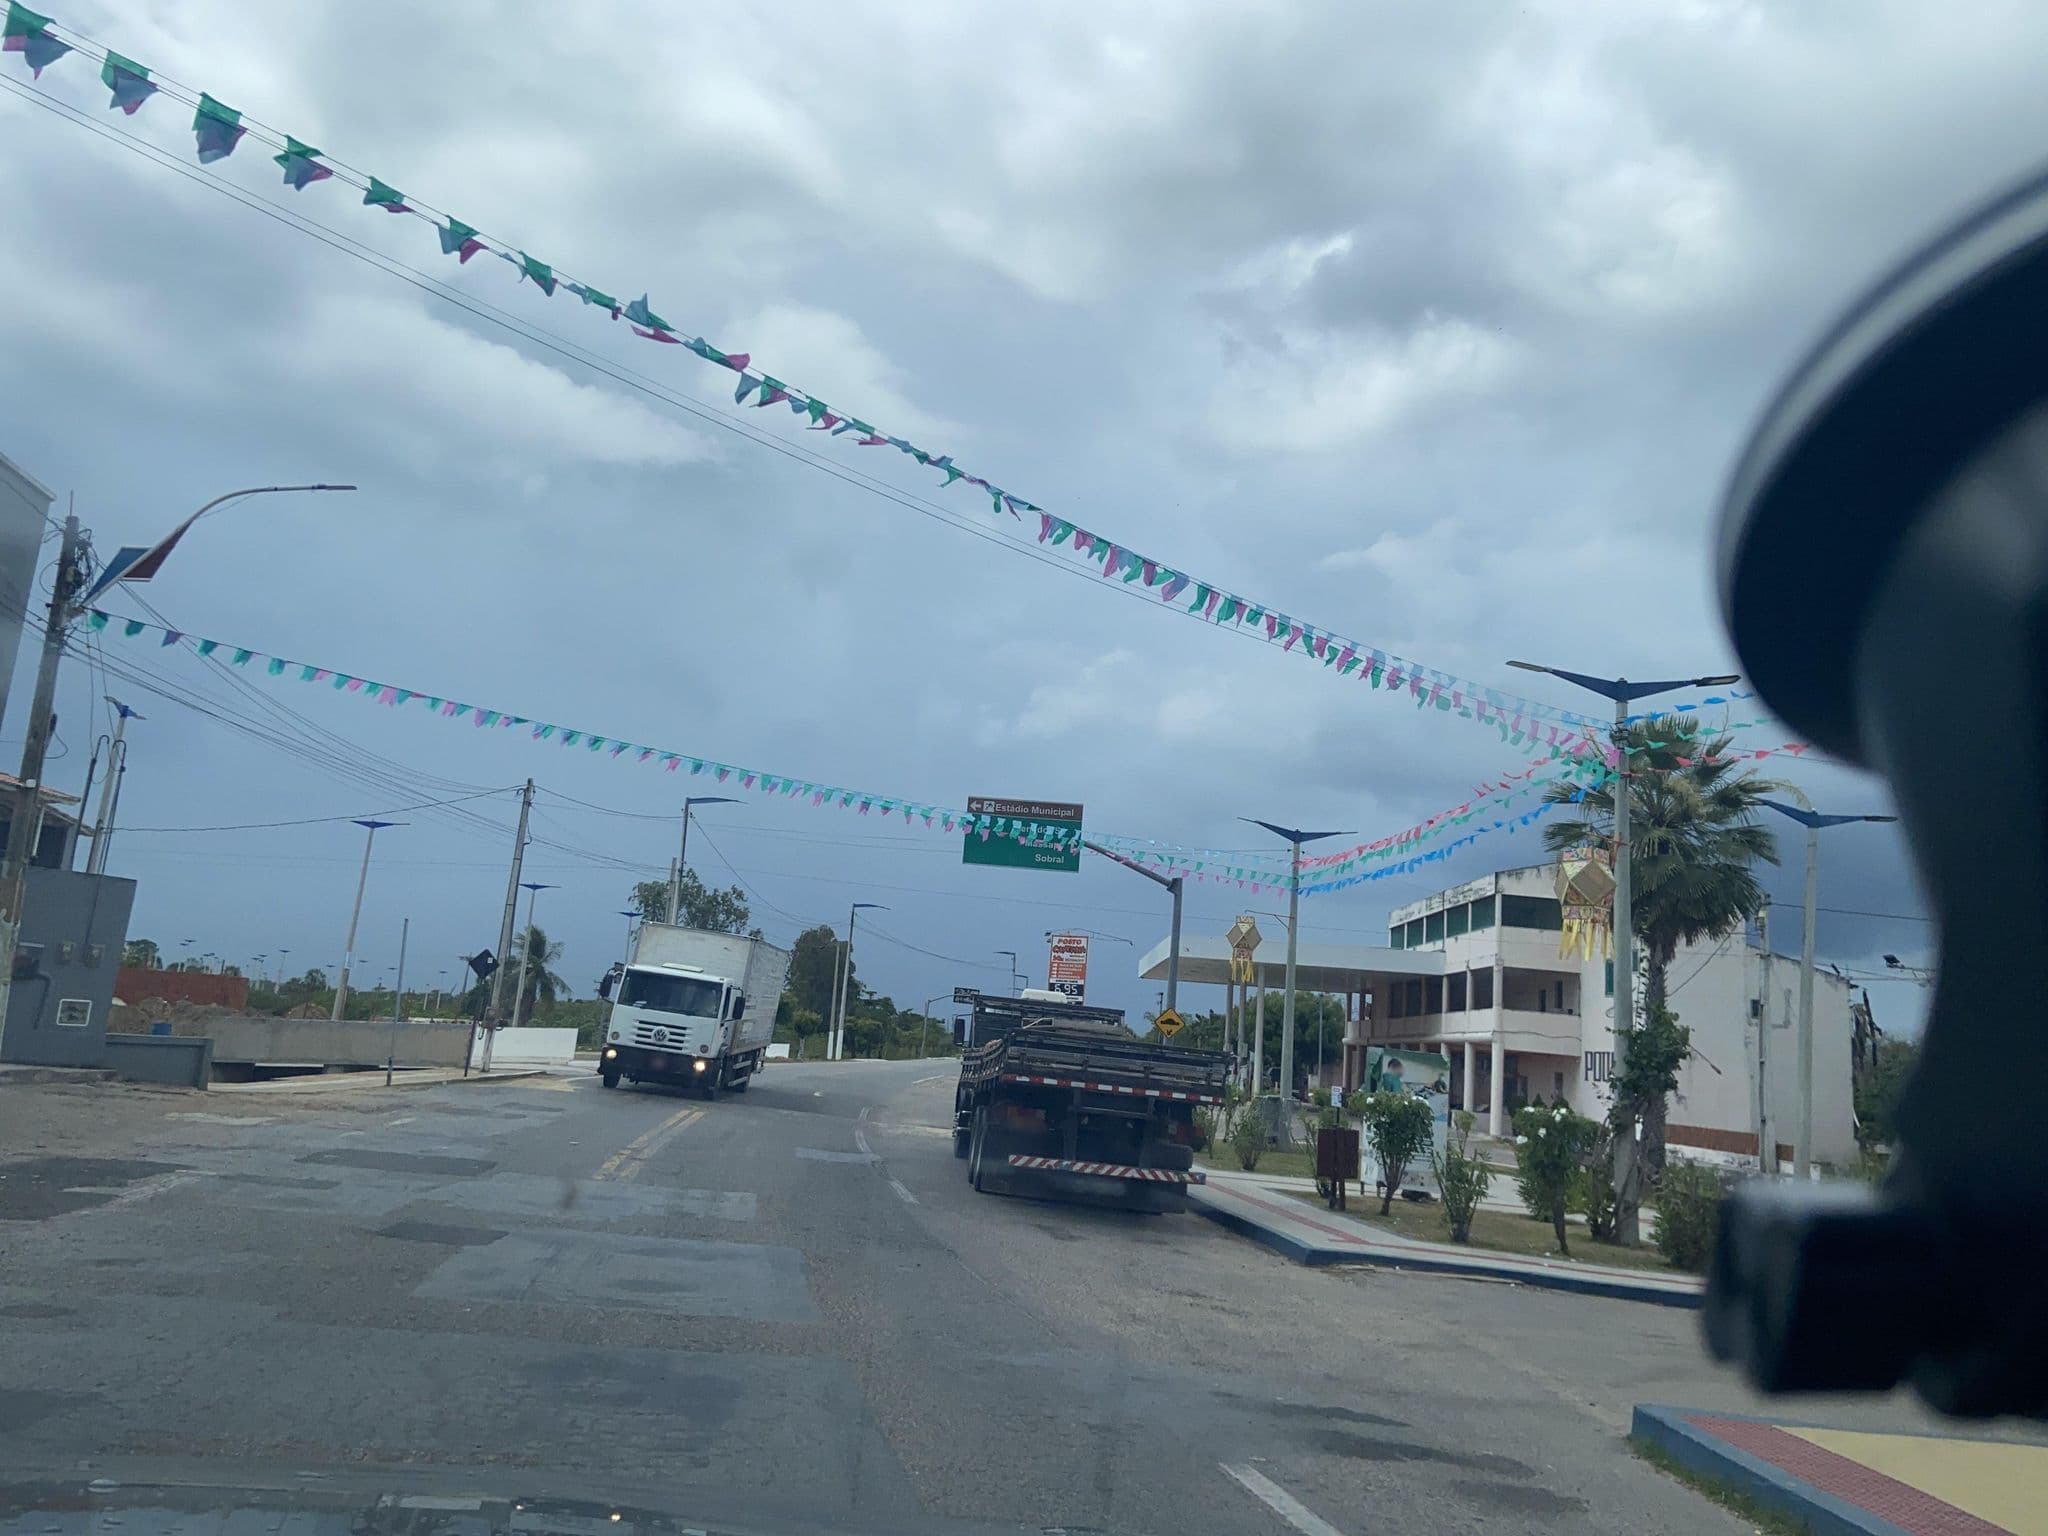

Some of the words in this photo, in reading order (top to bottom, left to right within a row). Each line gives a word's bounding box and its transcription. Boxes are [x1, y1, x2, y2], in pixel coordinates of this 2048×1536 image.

[995, 802, 1029, 814] Estádio
[1031, 806, 1074, 818] Municipal
[1034, 853, 1065, 864] Sobral
